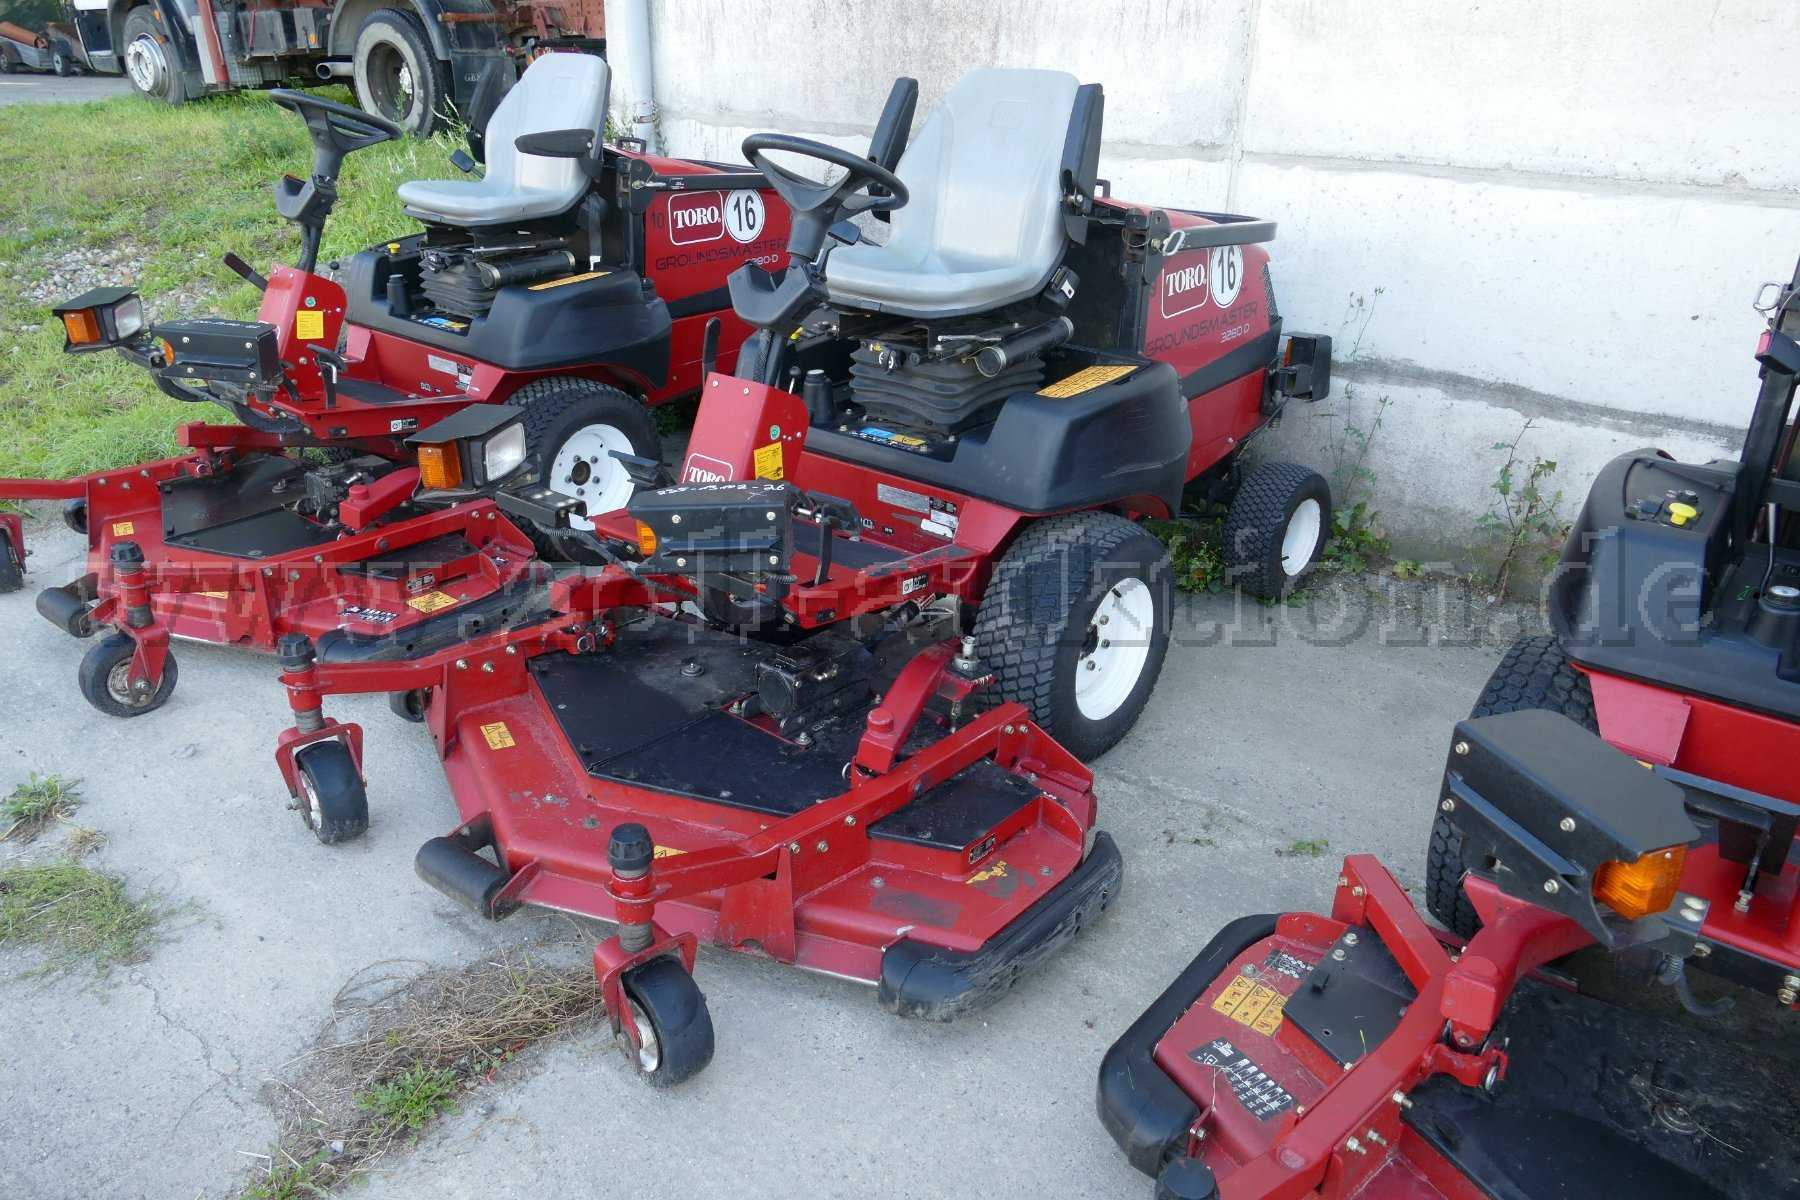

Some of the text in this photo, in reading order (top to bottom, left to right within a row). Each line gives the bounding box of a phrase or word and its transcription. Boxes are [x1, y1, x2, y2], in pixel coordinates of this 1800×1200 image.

[674, 206, 721, 229] TORO
[733, 195, 756, 232] 16
[655, 240, 787, 271] GROUNDSMASTER
[1217, 246, 1236, 294] 16
[1166, 263, 1206, 297] TORO
[1146, 300, 1259, 357] GROUNDSMASTER
